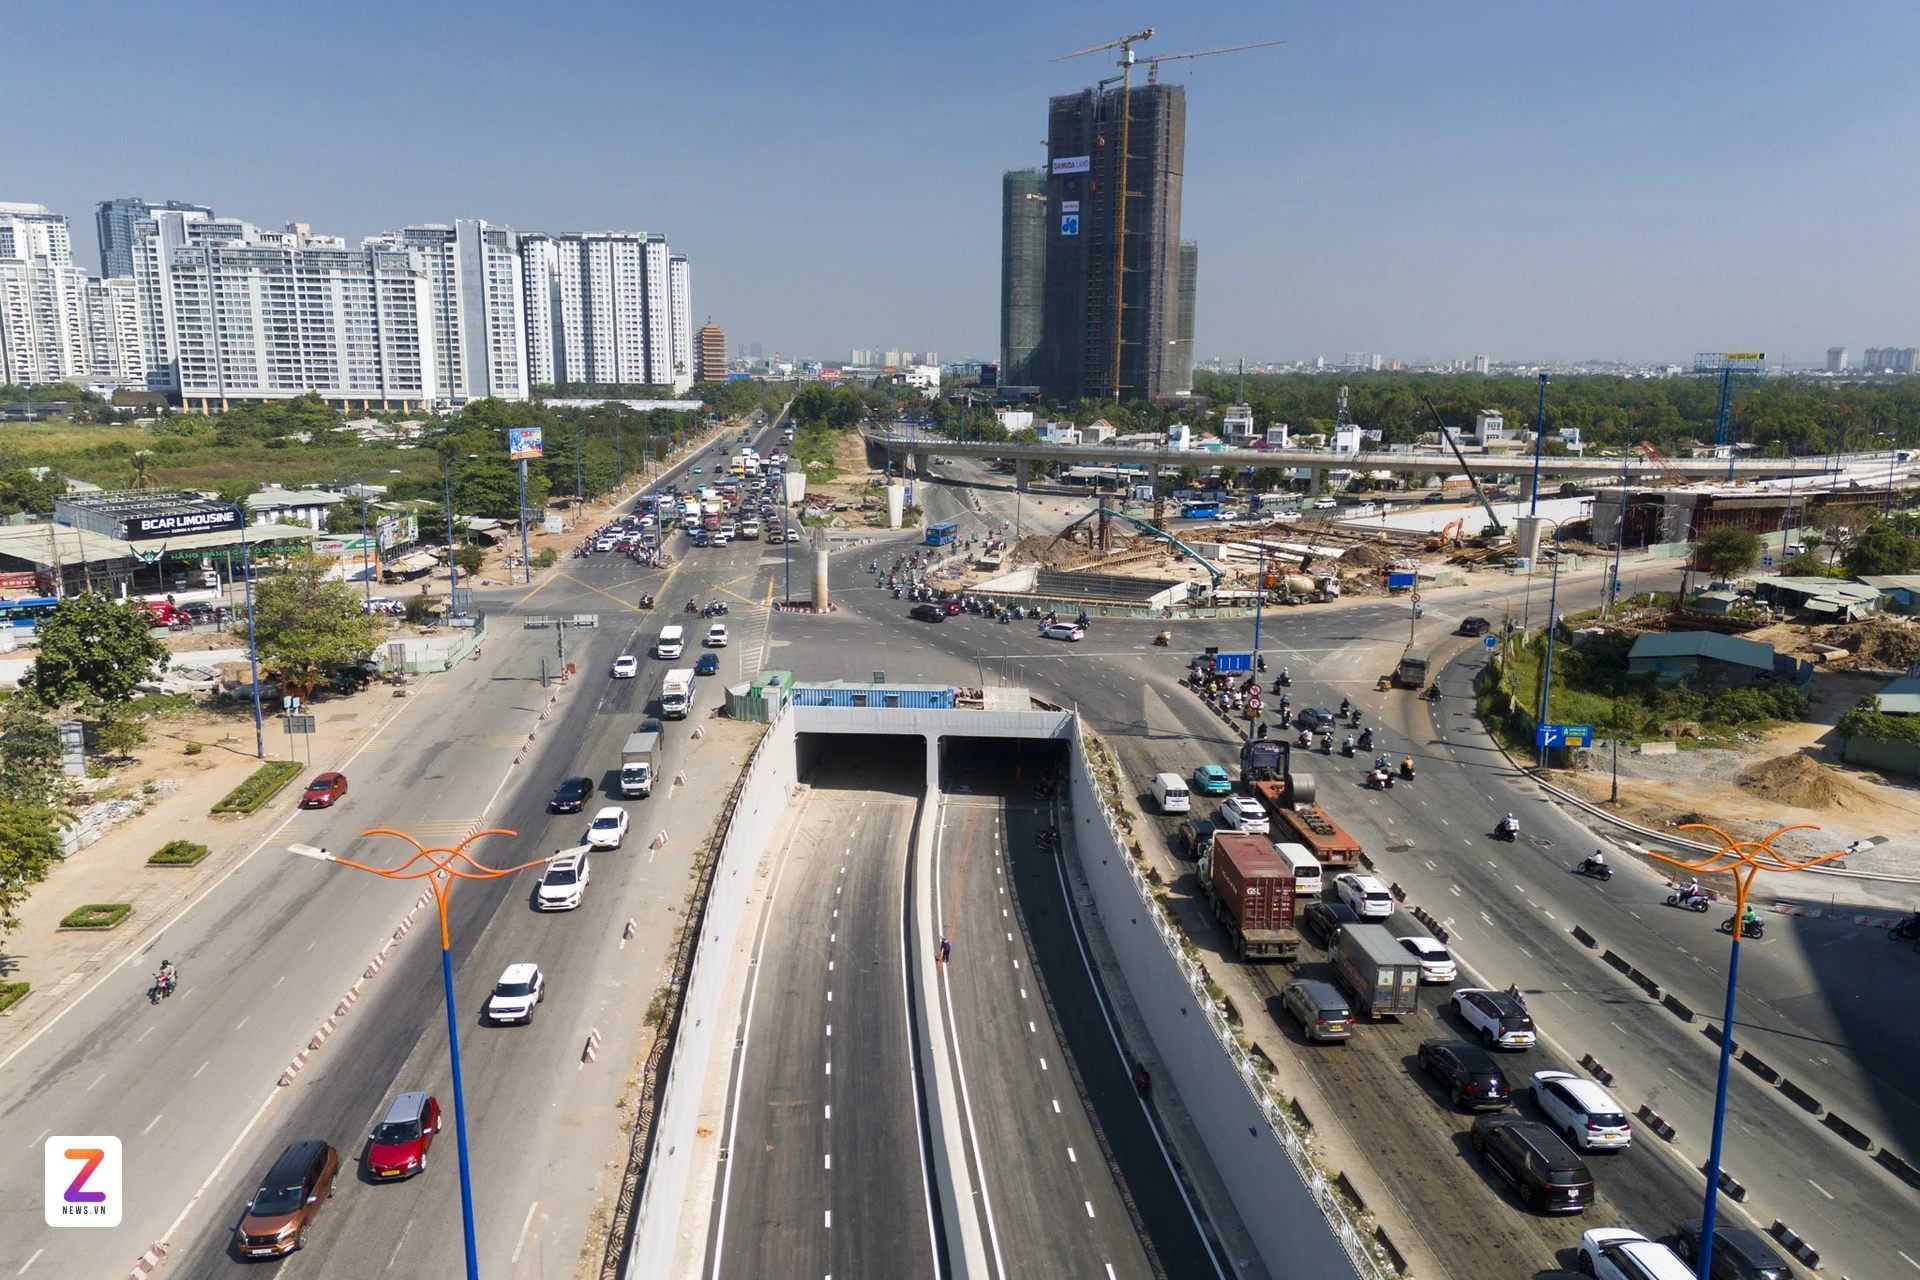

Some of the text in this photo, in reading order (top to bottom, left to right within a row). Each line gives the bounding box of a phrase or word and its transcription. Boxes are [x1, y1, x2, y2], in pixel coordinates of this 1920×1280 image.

[1054, 160, 1089, 170] GAMUDA LAND
[141, 512, 235, 531] BCAR LIMOUSINE
